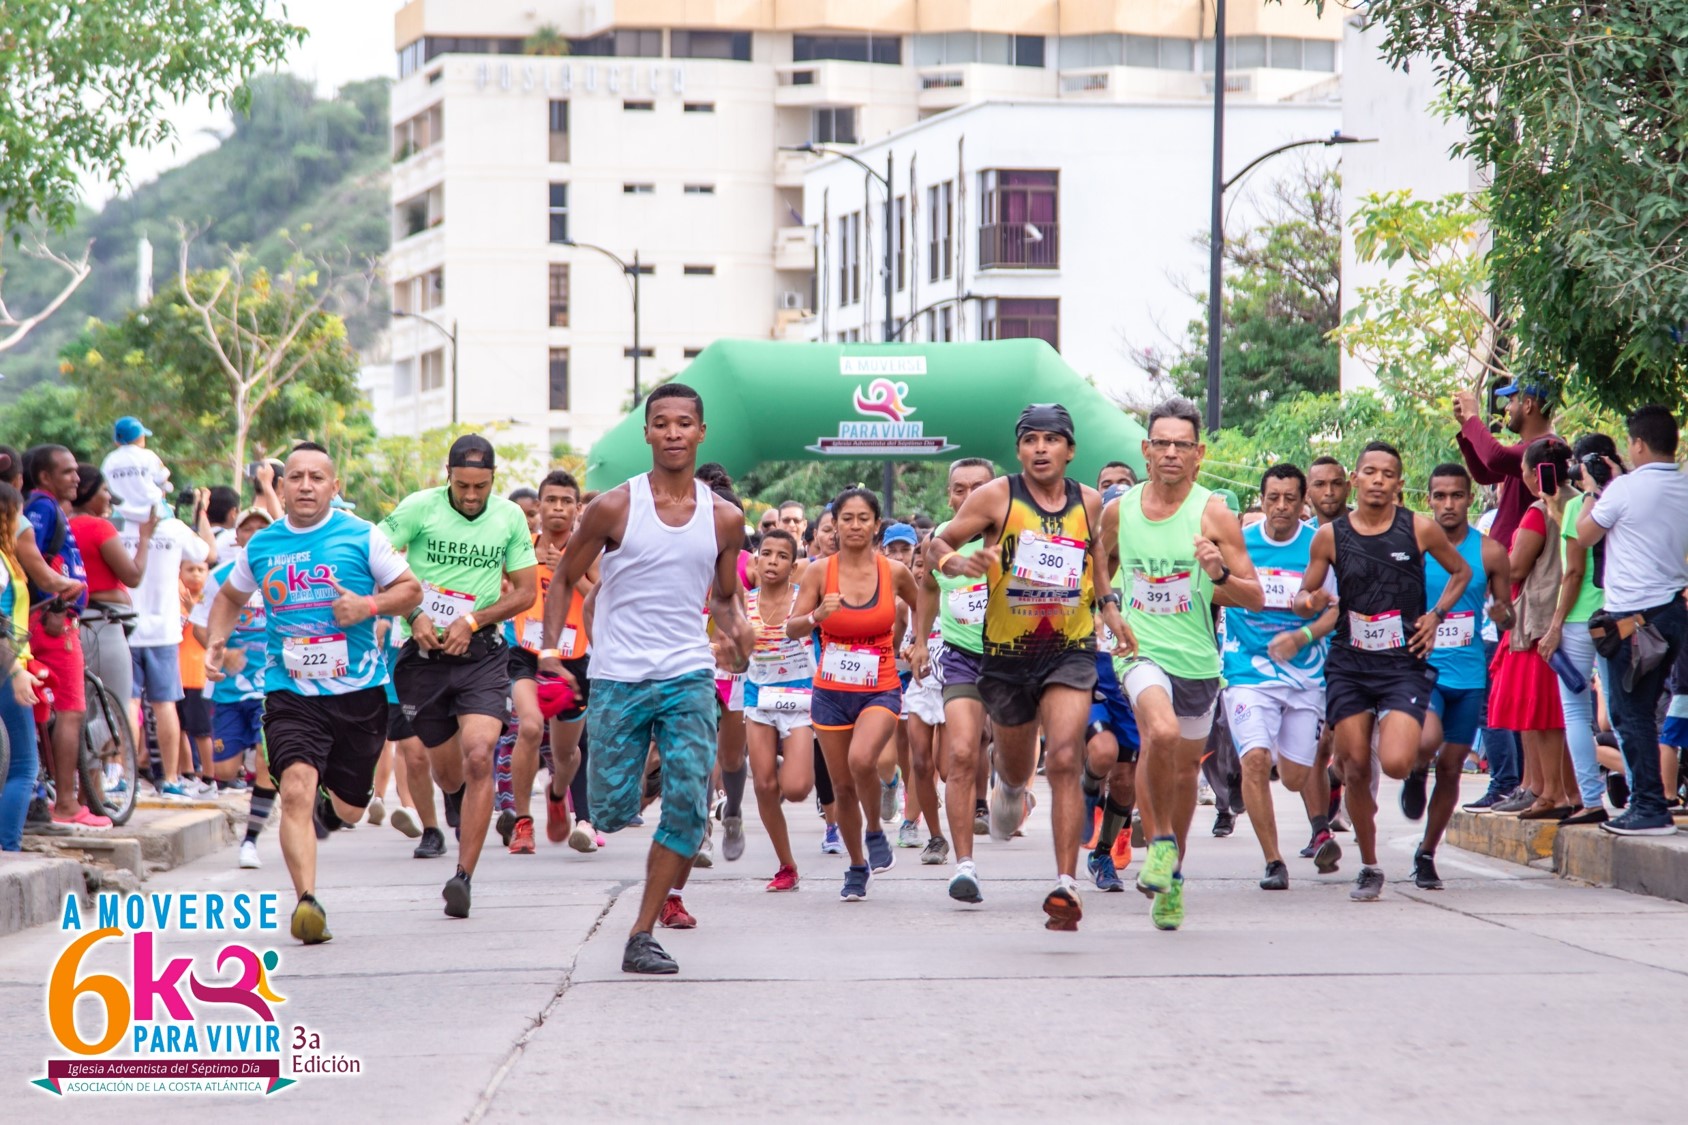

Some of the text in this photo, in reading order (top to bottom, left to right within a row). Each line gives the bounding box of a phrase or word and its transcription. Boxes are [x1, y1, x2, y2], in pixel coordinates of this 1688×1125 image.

[844, 359, 923, 372] A MOVERSE
[841, 423, 920, 438] PARA VIVIR
[267, 550, 312, 567] A MOVERSE
[1038, 553, 1064, 569] 380
[1265, 584, 1285, 595] 243
[291, 590, 314, 602] PARA
[1147, 591, 1171, 602] 391
[431, 601, 455, 616] 010
[1364, 629, 1385, 639] 347
[1438, 627, 1459, 637] 513
[302, 653, 328, 666] 222
[840, 660, 861, 672] 529
[775, 701, 797, 710] 049
